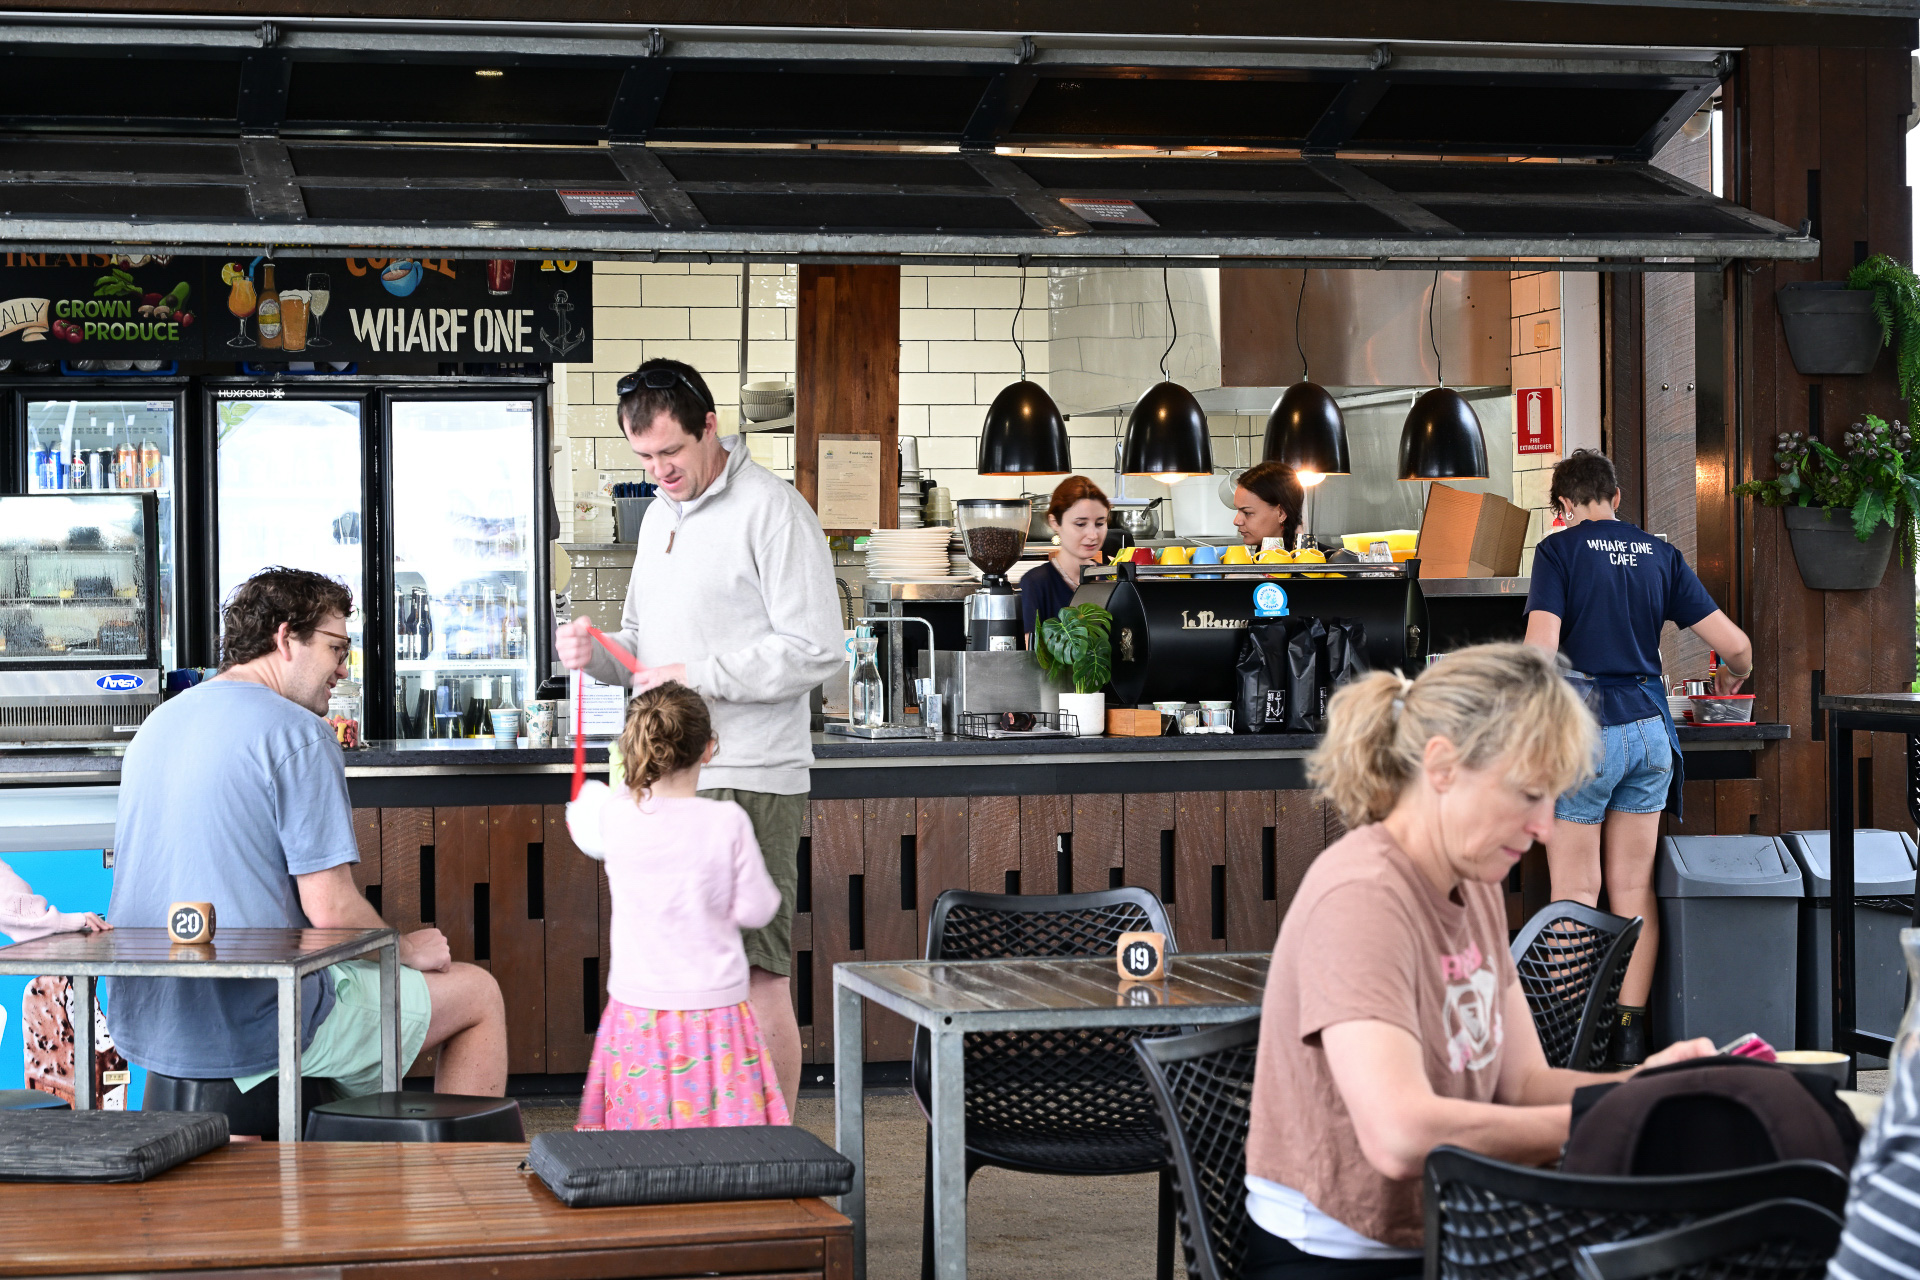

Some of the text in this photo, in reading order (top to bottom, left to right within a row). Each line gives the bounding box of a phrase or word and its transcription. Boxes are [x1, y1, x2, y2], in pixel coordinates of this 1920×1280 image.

[0, 302, 45, 331] ALLY
[56, 300, 132, 318] GROWN
[84, 322, 180, 340] PRODUCE
[349, 308, 534, 353] WHARF ONE
[218, 389, 266, 398] HUXFORD
[1587, 540, 1653, 554] WHARF ONE
[1610, 553, 1637, 566] CAFE
[176, 913, 199, 933] 20
[1130, 948, 1149, 970] 19
